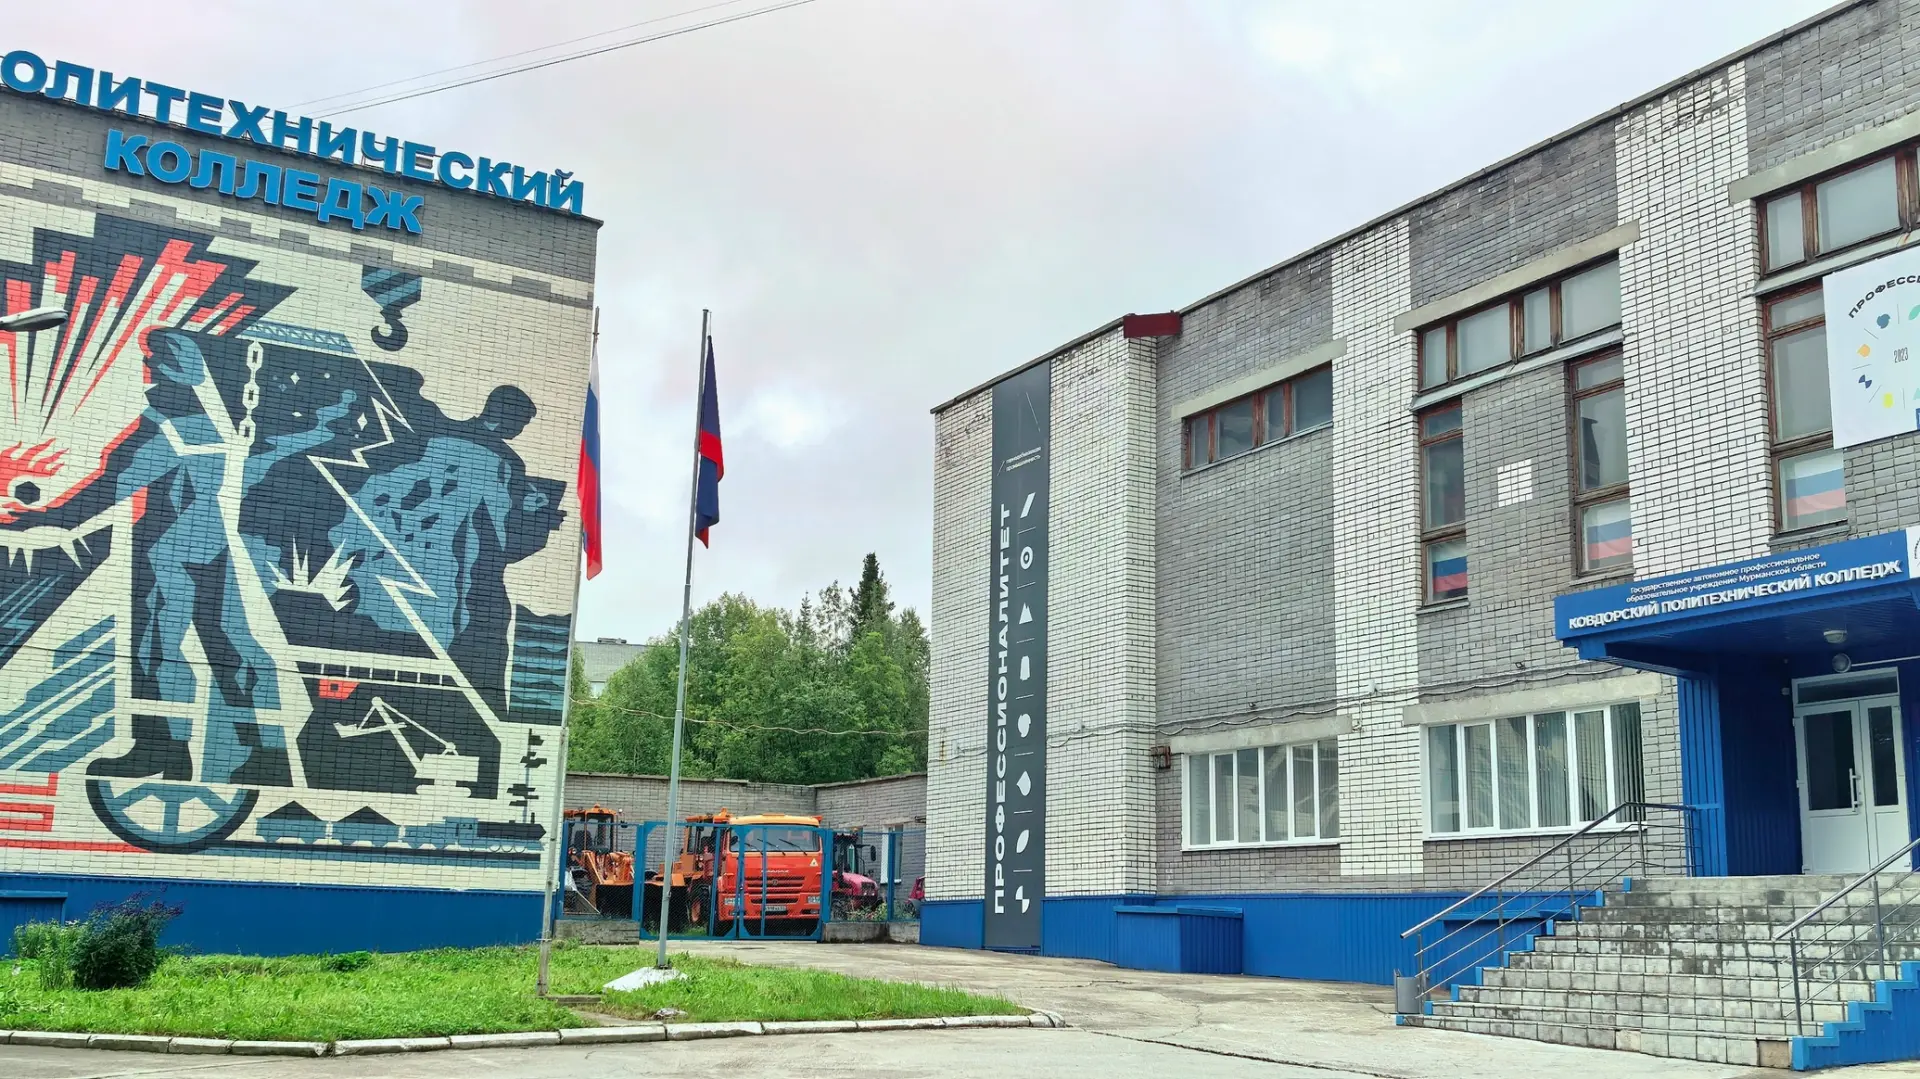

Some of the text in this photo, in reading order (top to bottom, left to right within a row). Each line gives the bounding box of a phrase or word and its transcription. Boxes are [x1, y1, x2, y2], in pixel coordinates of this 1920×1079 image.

[0, 50, 585, 215] ОЛИТЕХНИЧЕСКИЙ
[104, 128, 425, 235] КОЛЛЕДЖ
[1569, 559, 1903, 630] КОВДОРСКИЙ ПОЛИТЕХНИЧЕСКИЙ КОЛЛЕДЖ
[1626, 560, 1827, 603] образовательное учреждение Мурманской области
[1630, 553, 1820, 594] Государственное автономное профессиональное
[995, 503, 1010, 914] ПРОФЕССИОНАЛИТЕТ
